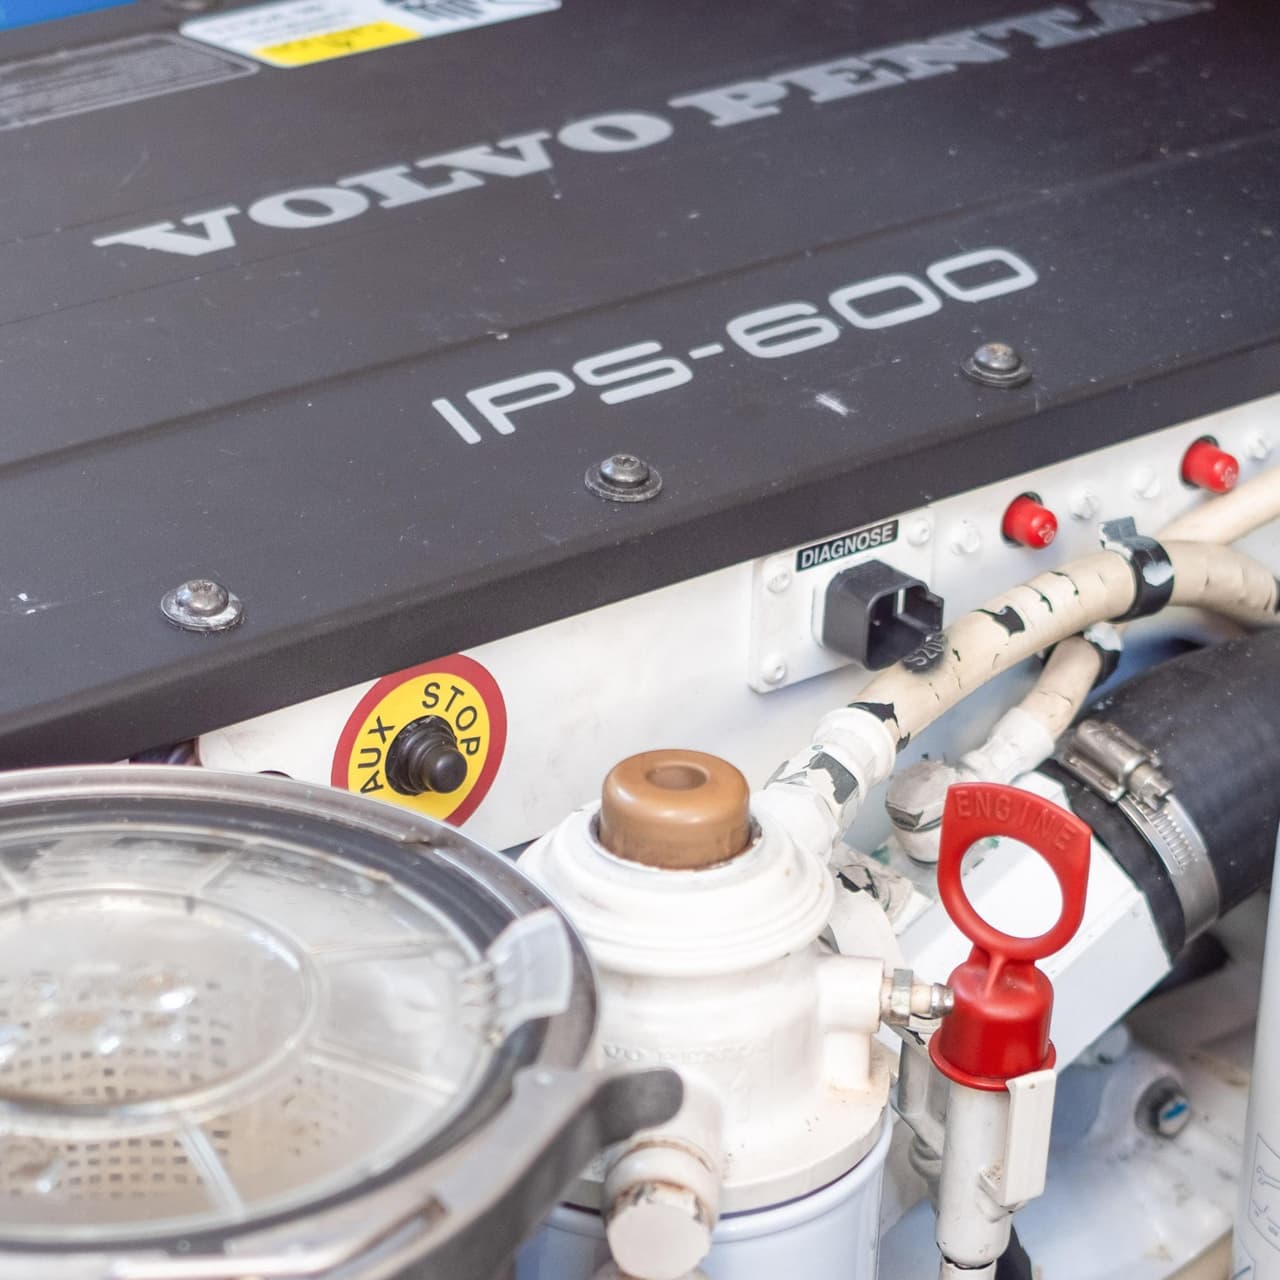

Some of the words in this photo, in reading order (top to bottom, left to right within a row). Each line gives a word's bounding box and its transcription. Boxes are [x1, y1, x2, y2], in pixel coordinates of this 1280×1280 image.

[92, 112, 674, 257] VOLVO
[668, 0, 1215, 127] PENTA
[431, 247, 1039, 444] IPS-600
[800, 523, 894, 569] DIAGNOSE
[1038, 524, 1055, 544] 20
[358, 715, 396, 794] AUX
[421, 681, 481, 756] STOP
[954, 790, 1078, 850] ENGINE
